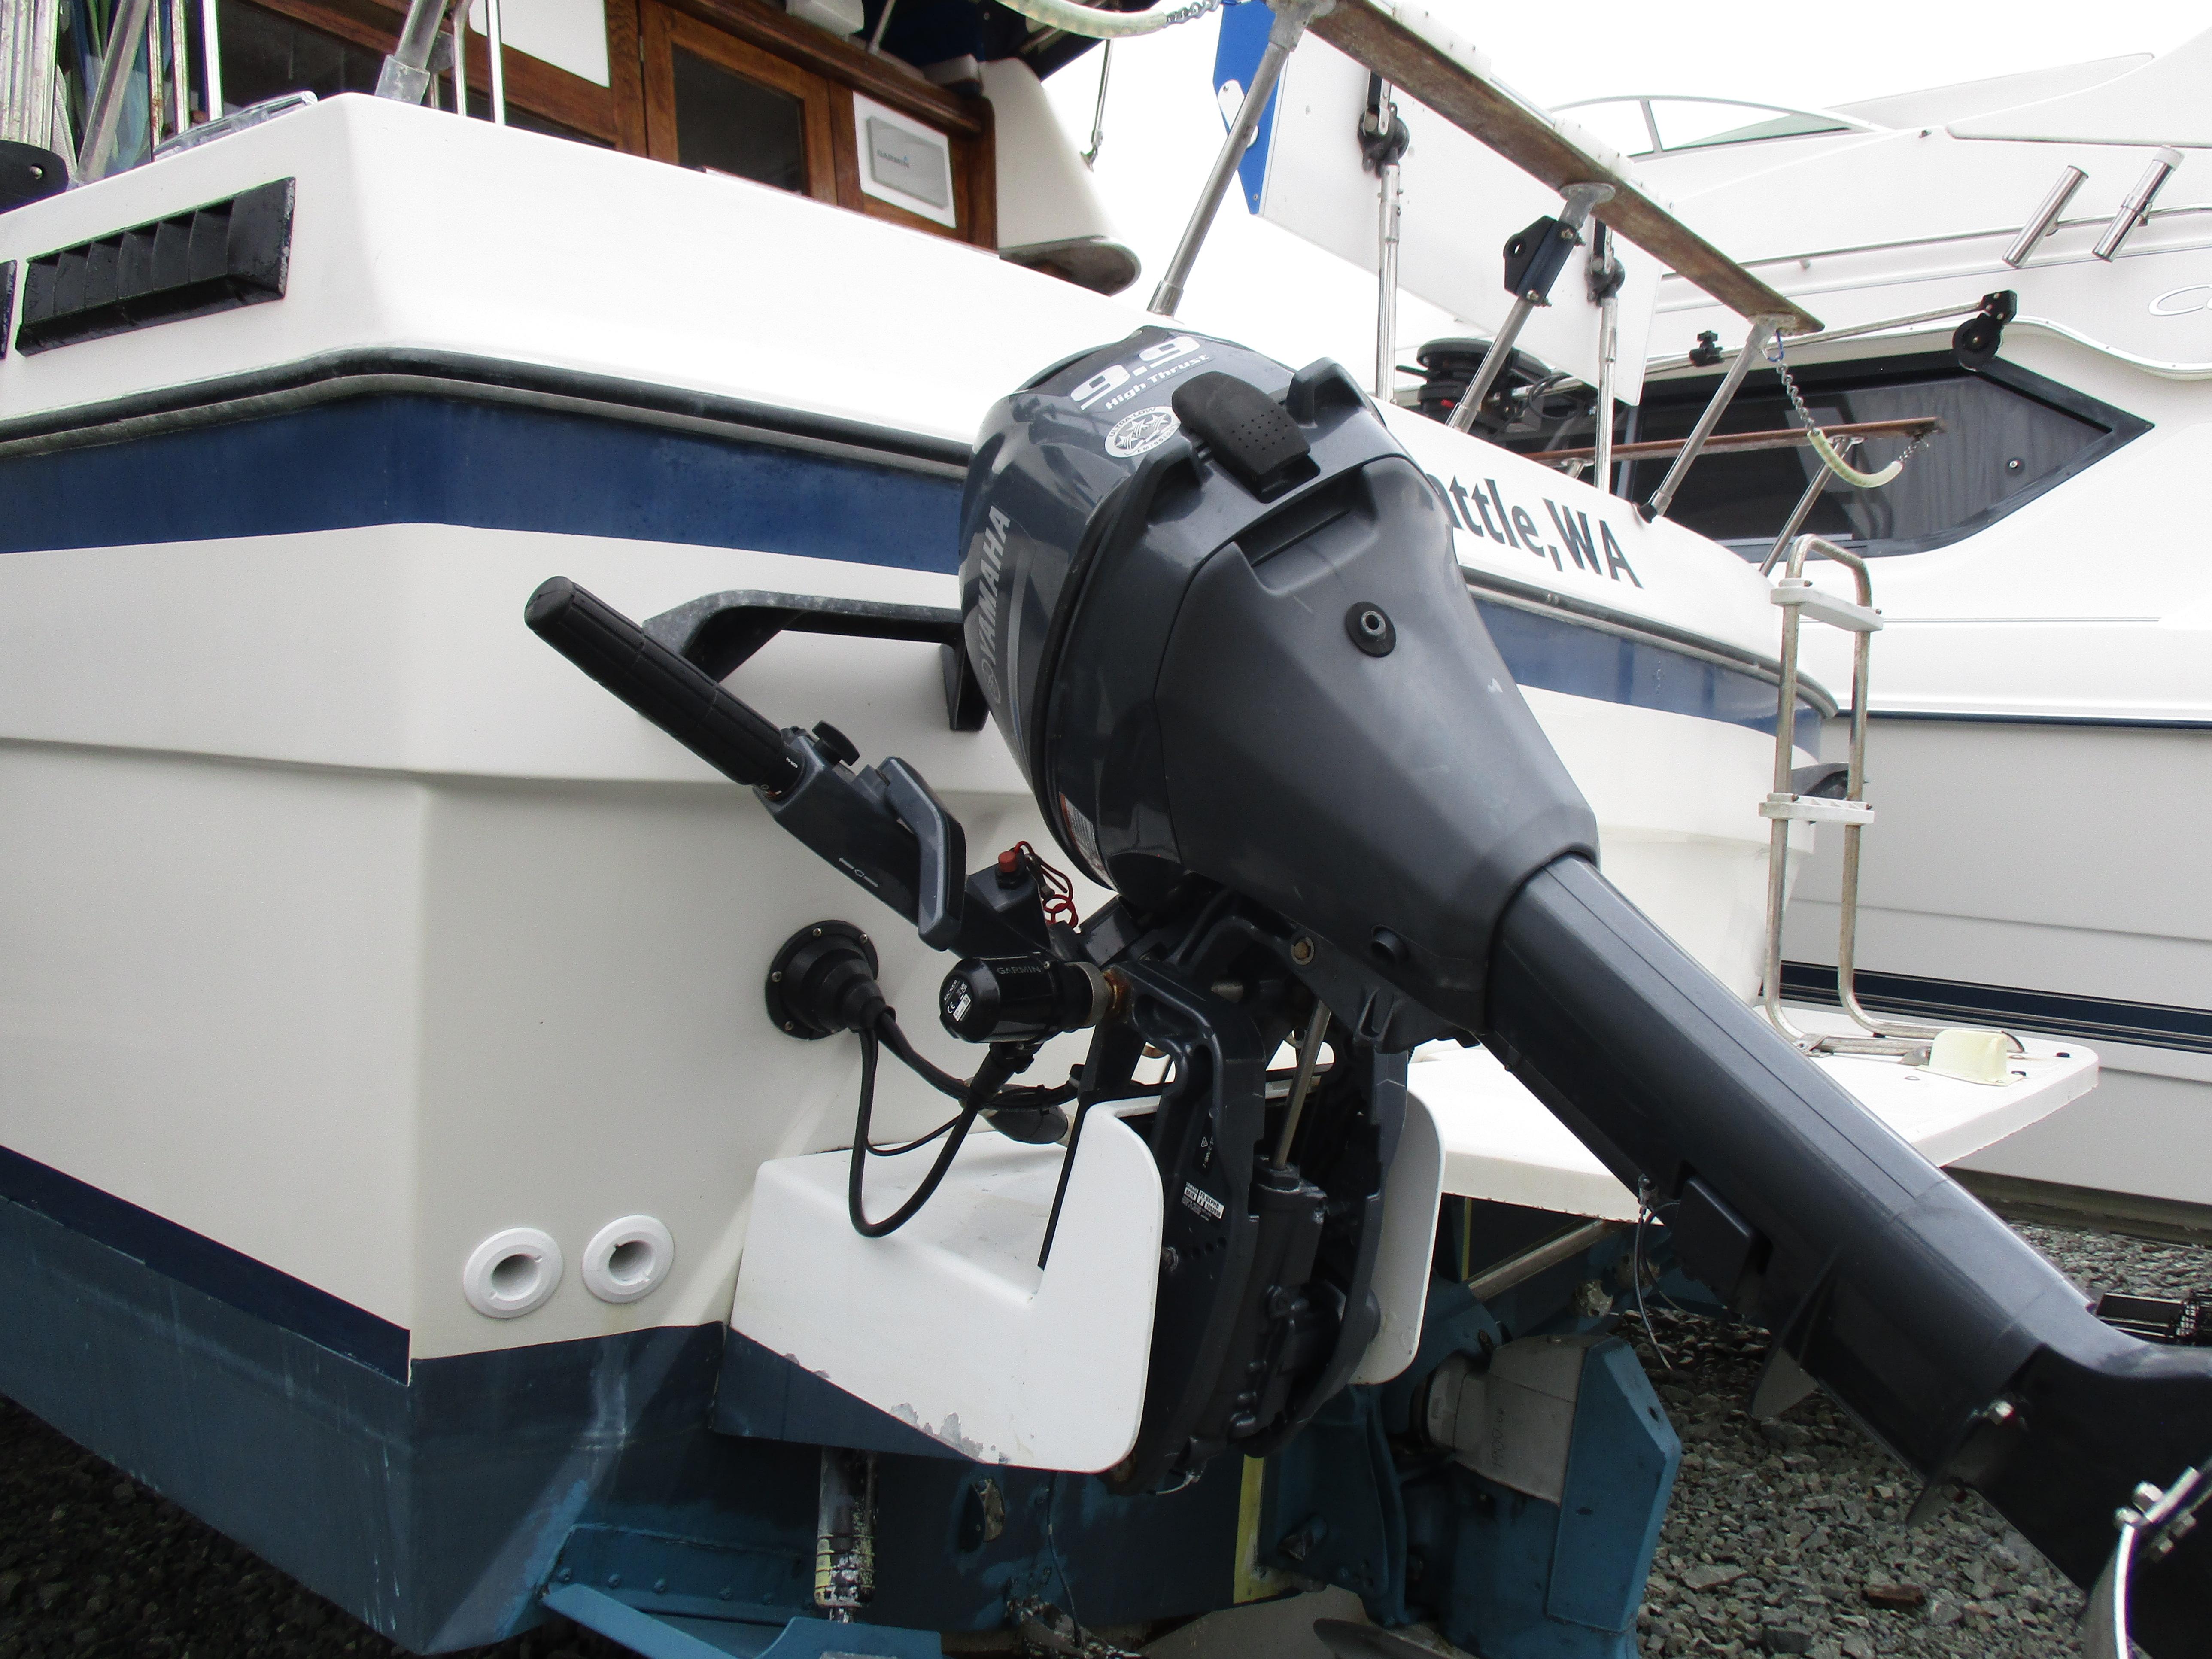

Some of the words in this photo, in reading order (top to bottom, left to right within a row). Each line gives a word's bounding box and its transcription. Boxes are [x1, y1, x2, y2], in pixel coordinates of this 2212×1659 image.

[1070, 336, 1200, 410] 9.9
[1105, 383, 1147, 410] High
[1147, 354, 1209, 383] Thrust
[978, 505, 1011, 665] YAMAHA
[944, 980, 958, 1001] KICKER
[997, 966, 1041, 975] GARMIN
